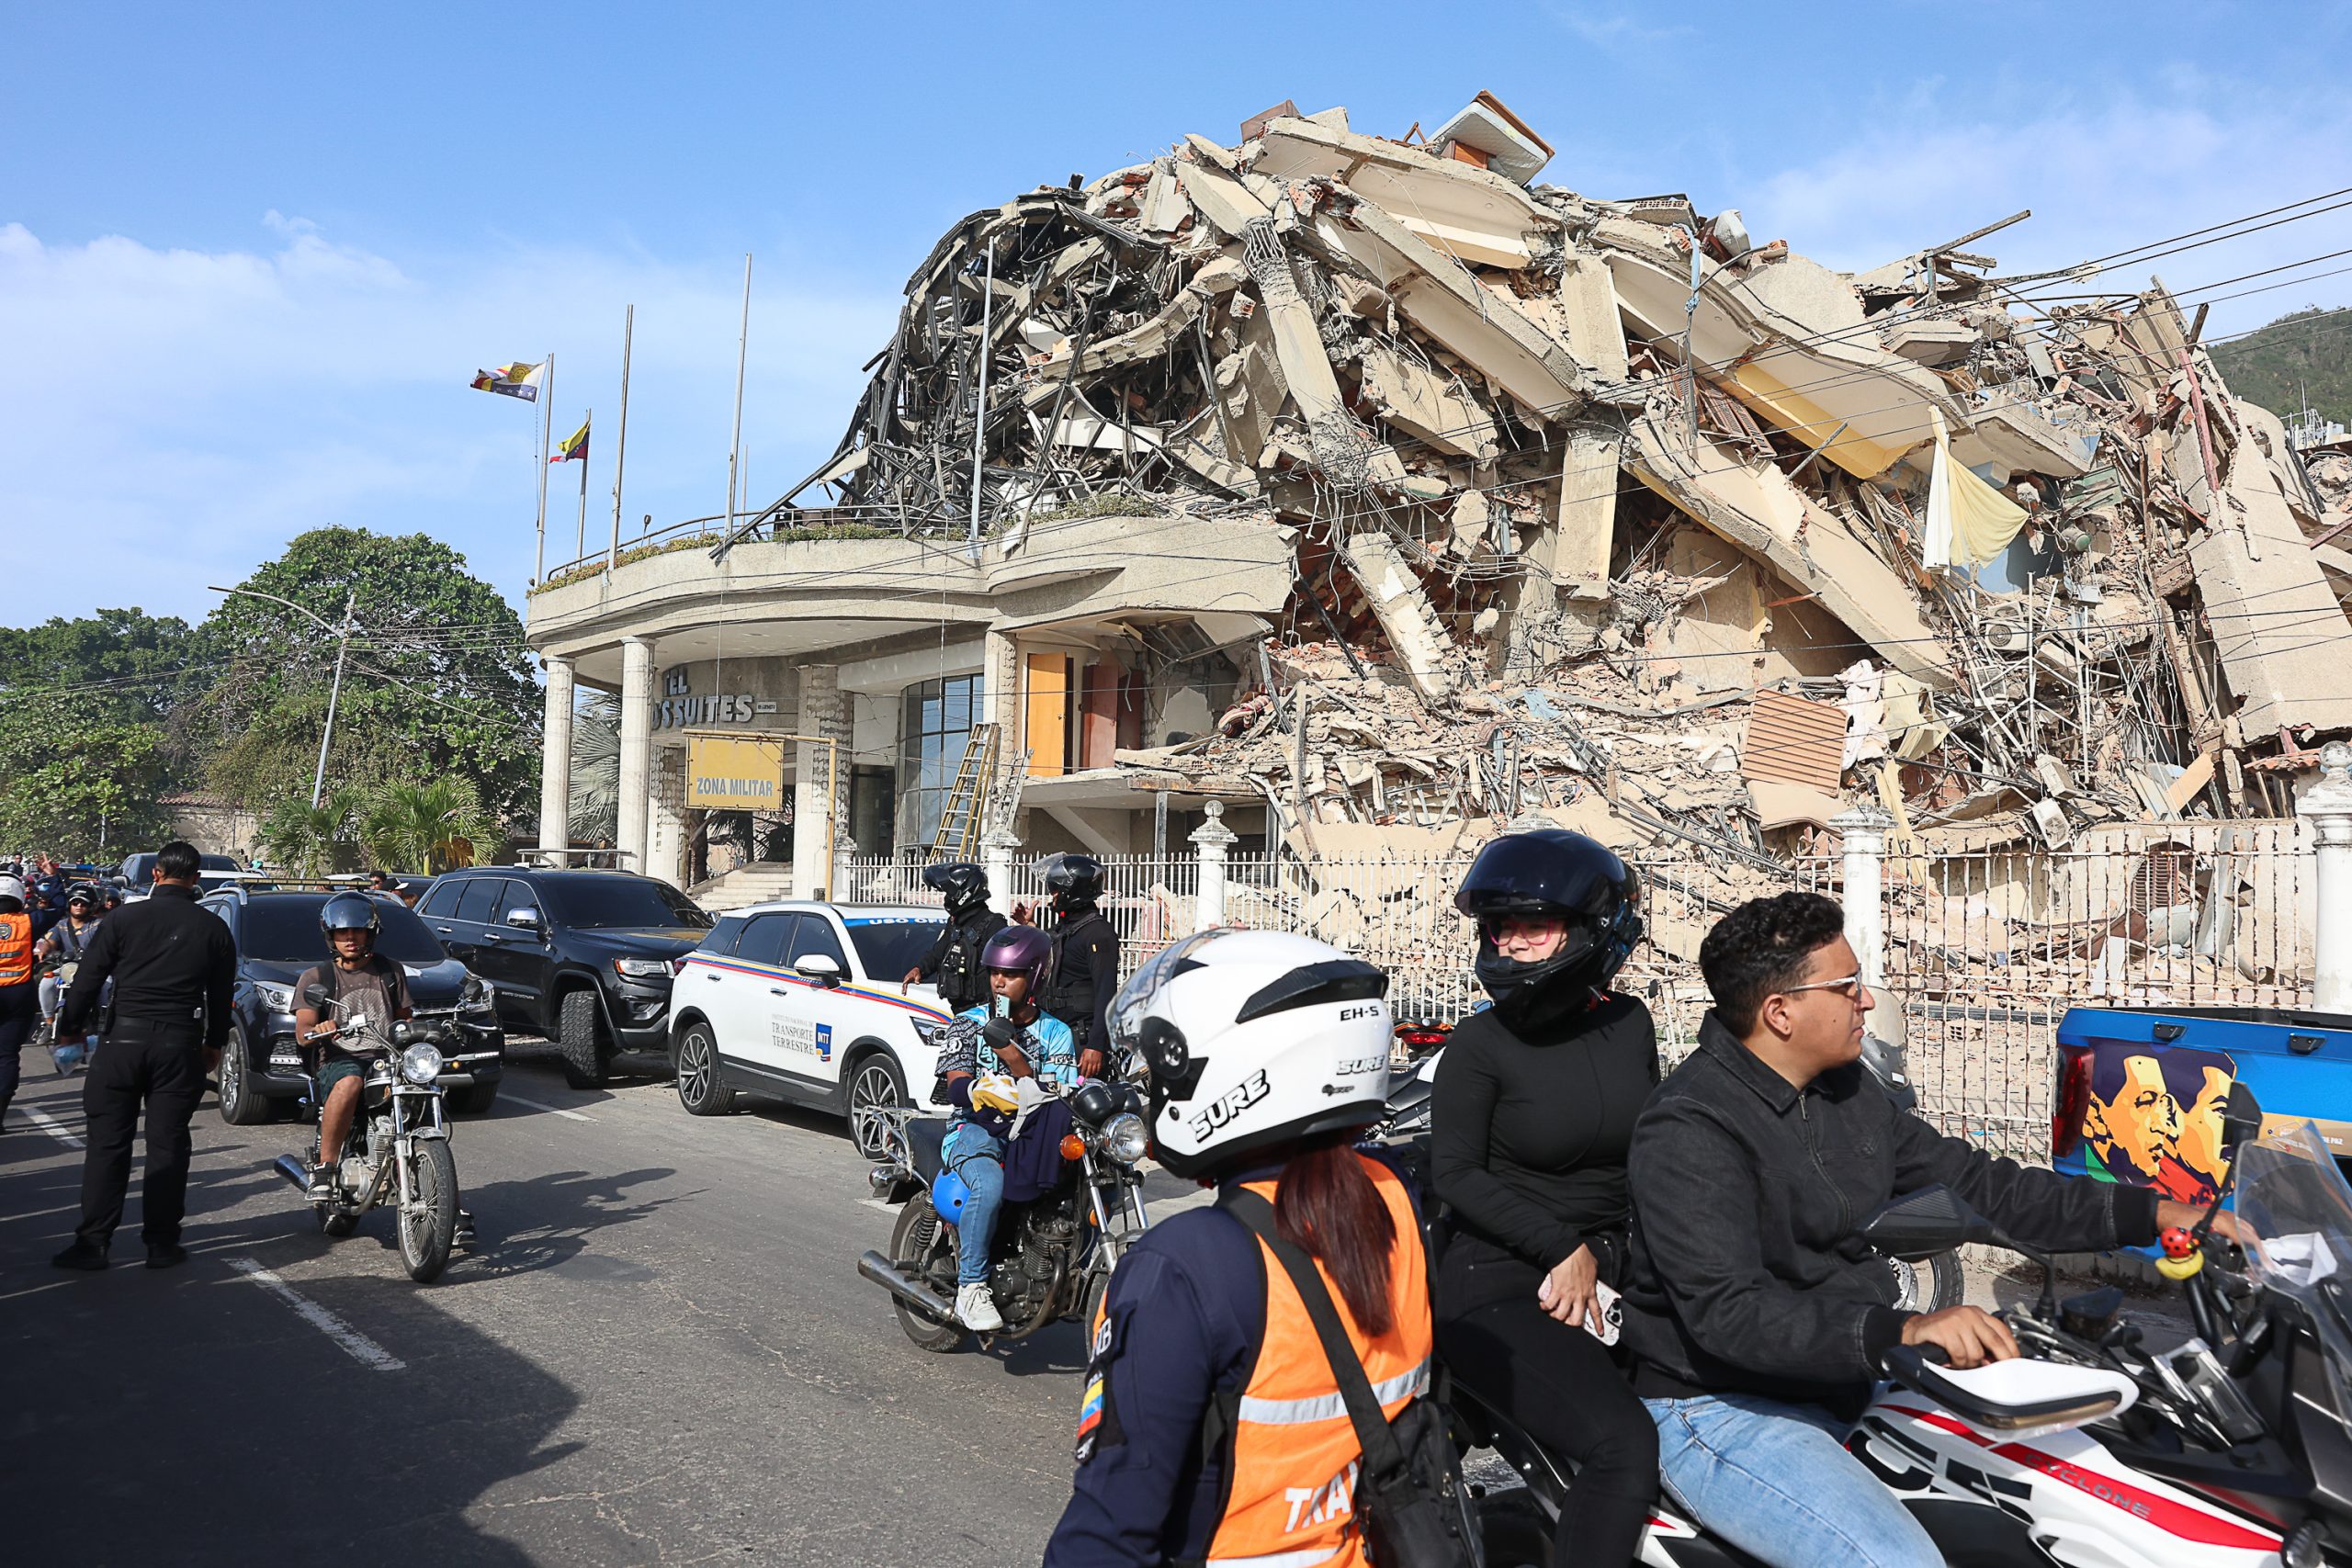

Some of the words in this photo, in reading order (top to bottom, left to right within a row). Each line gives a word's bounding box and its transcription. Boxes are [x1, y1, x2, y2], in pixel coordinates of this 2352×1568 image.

[673, 694, 753, 727] SUITES
[696, 777, 726, 795] ZONA
[729, 778, 773, 796] MILITAR
[772, 1021, 813, 1042] TRANSPORTE
[772, 1035, 814, 1055] TERRESTRE
[1336, 1055, 1385, 1076] SURE
[1187, 1068, 1271, 1144] SURE
[2025, 1453, 2152, 1518] CYCLONE
